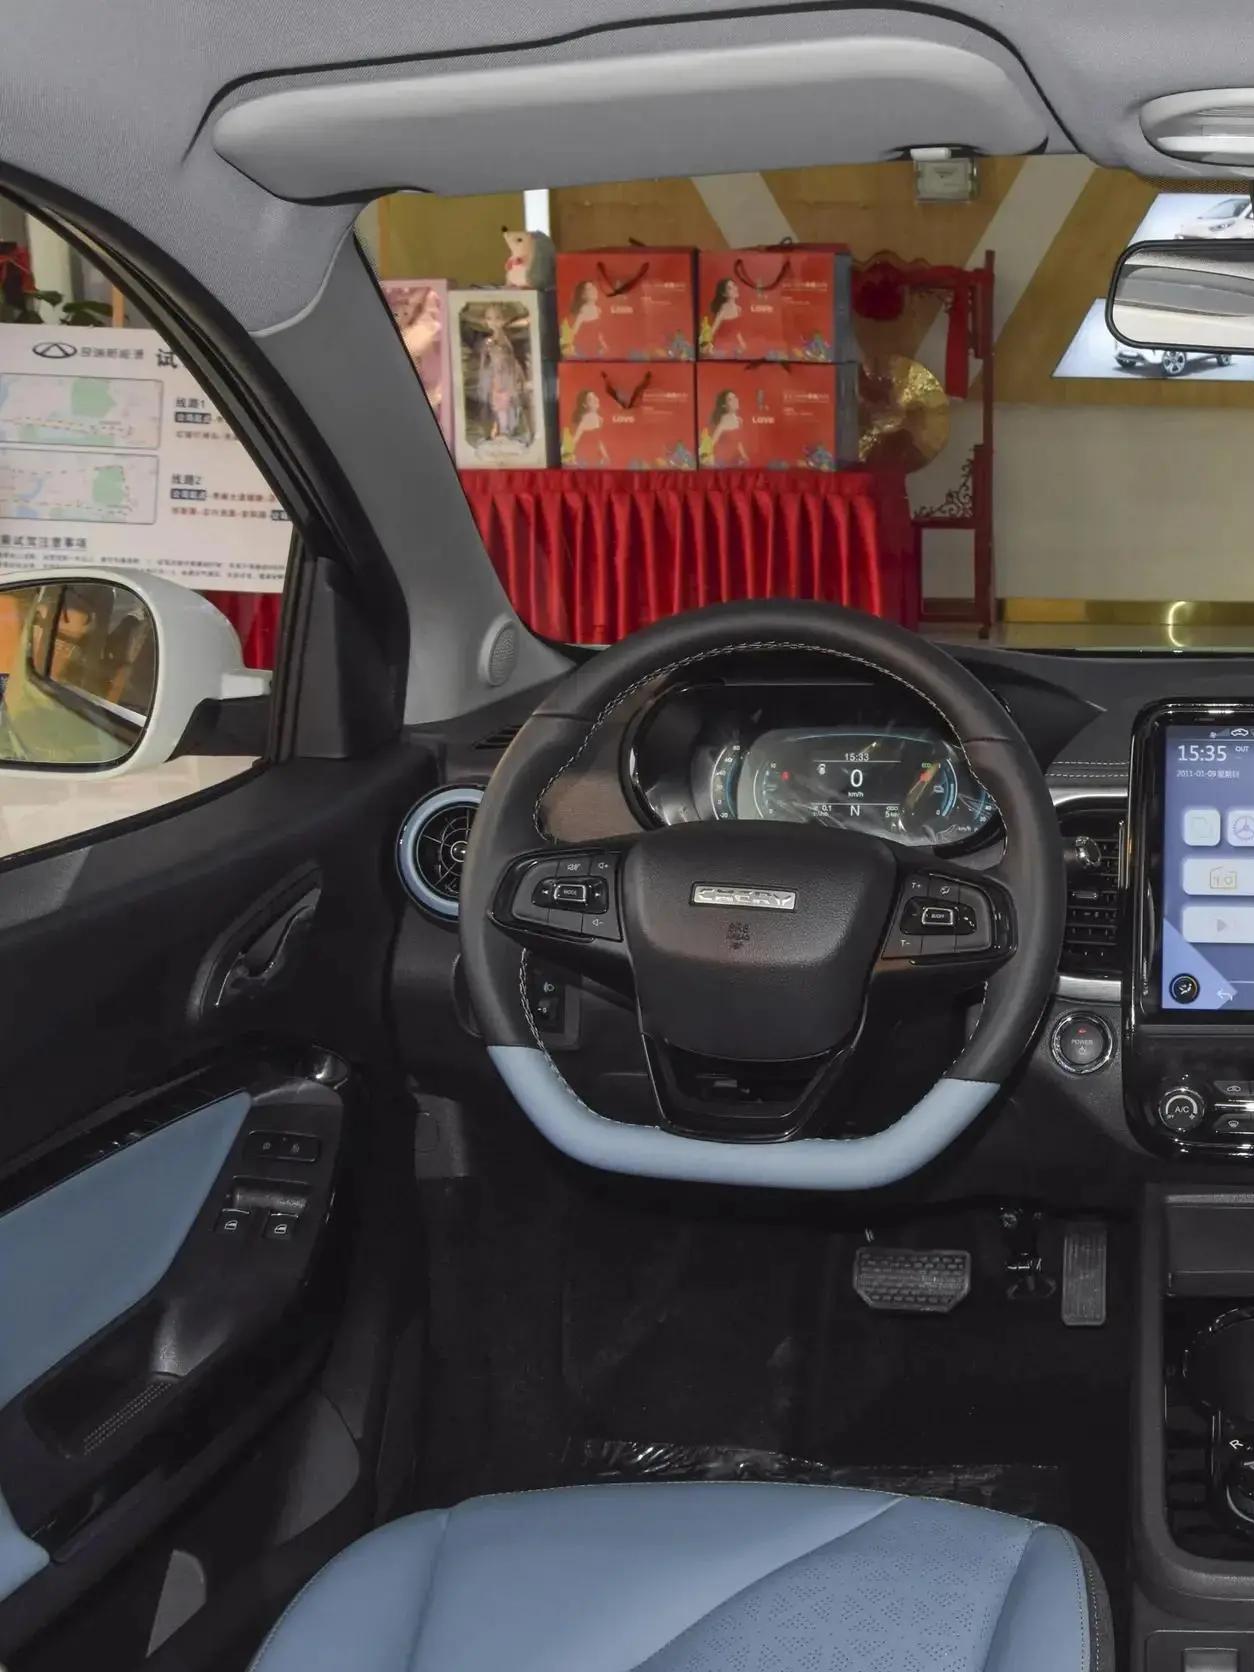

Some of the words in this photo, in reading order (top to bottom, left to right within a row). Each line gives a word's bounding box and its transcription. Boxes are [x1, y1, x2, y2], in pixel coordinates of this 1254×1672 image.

[844, 752, 870, 761] 15:33
[1178, 745, 1227, 761] 15:35
[850, 769, 863, 787] 0
[850, 806, 860, 816] N
[1174, 1105, 1190, 1113] A/C
[1229, 1439, 1244, 1450] R
